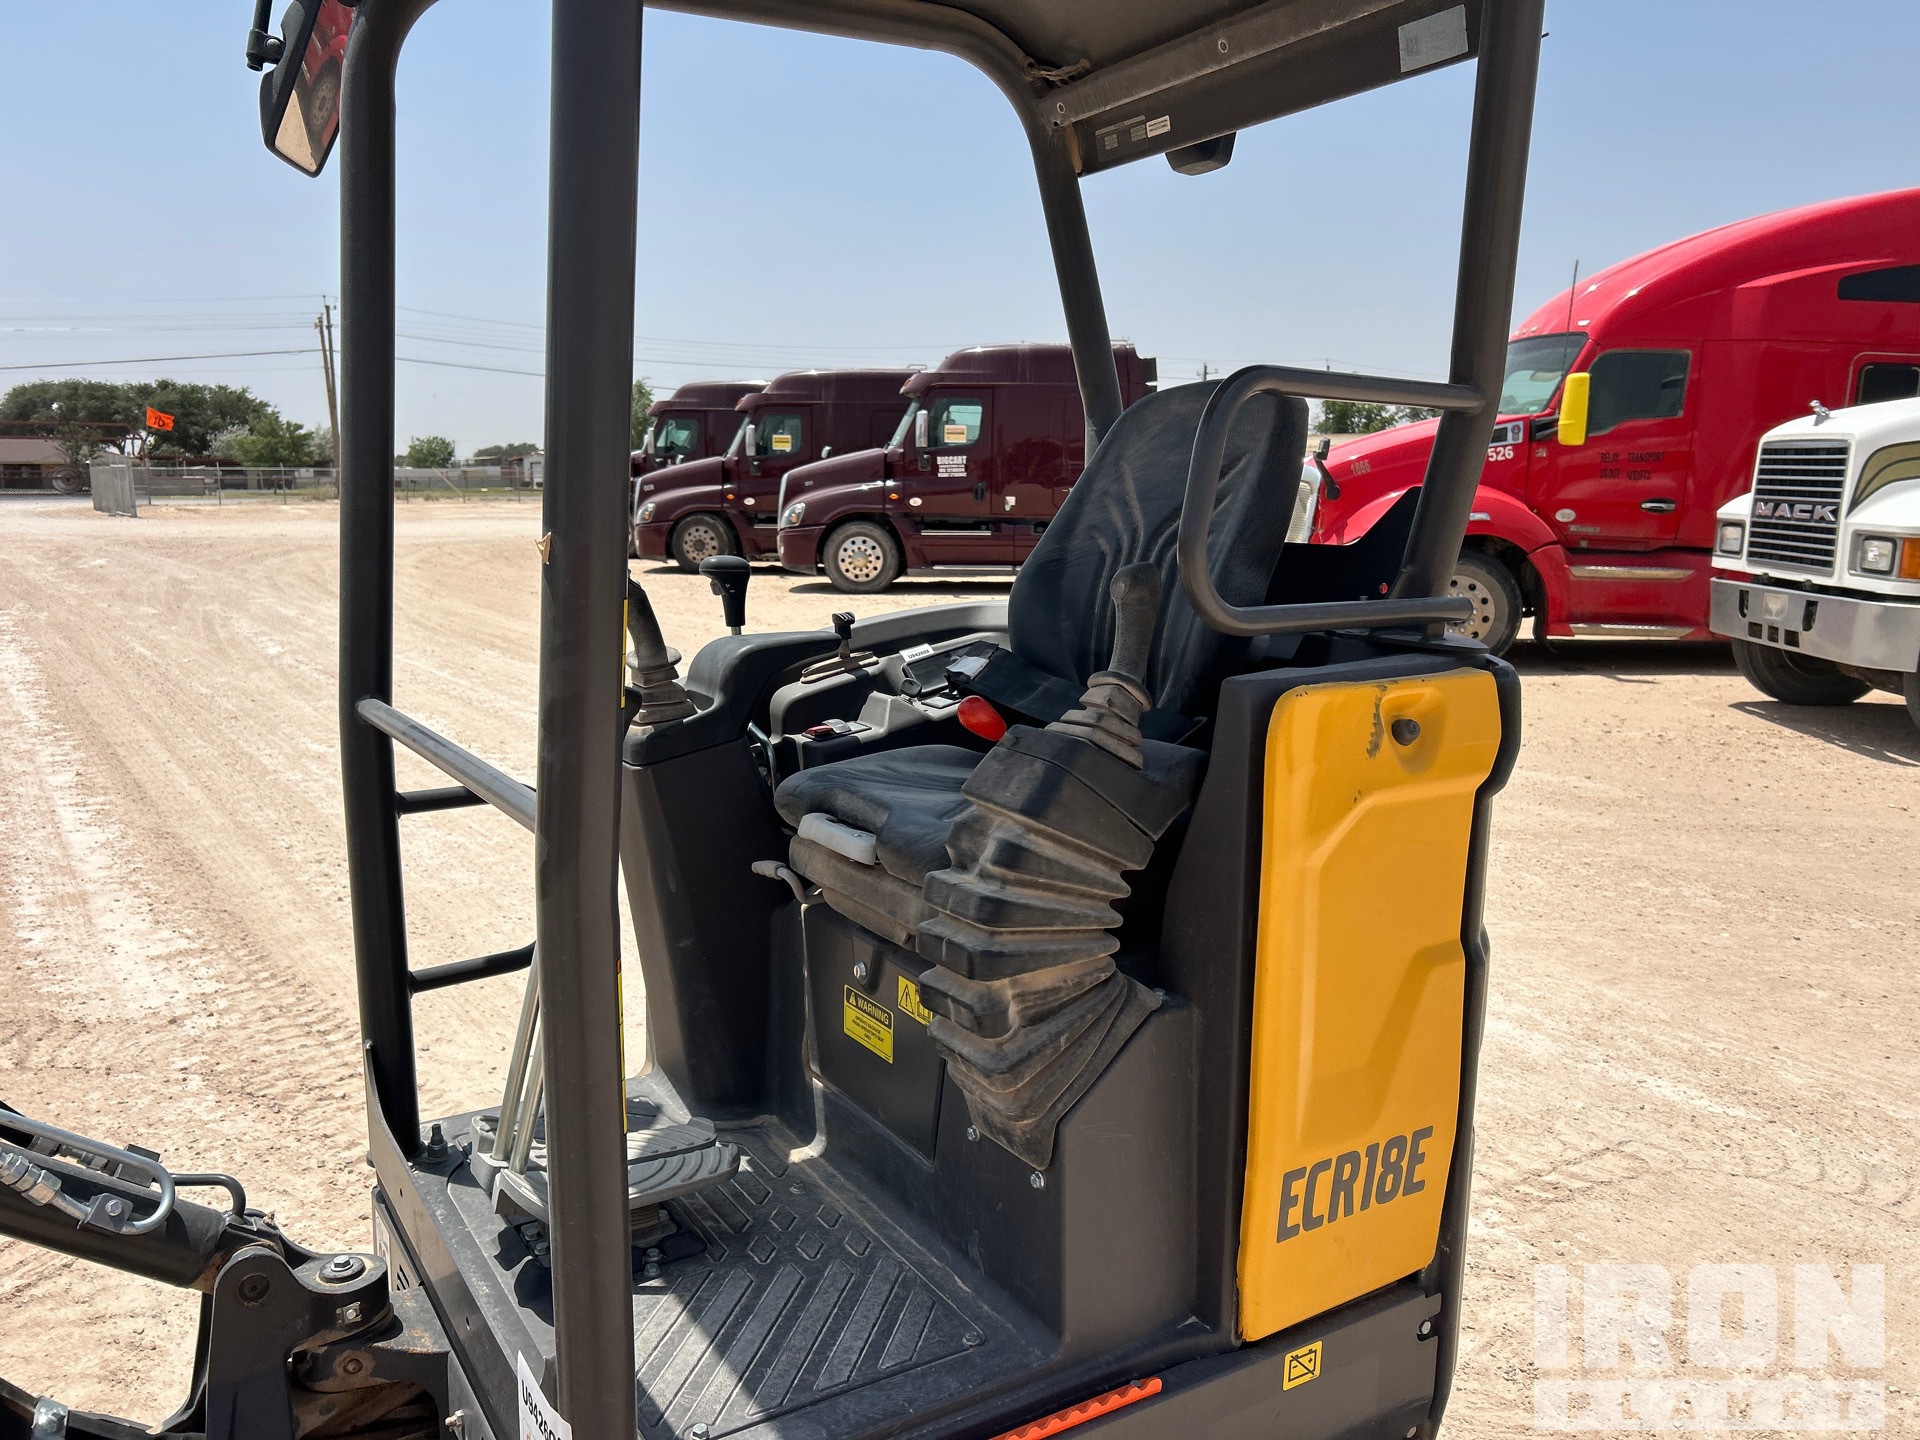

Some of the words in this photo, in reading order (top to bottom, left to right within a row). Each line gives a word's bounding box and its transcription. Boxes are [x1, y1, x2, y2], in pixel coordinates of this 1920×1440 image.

[1488, 445, 1514, 462] 526
[1755, 501, 1837, 522] MACK
[858, 997, 889, 1025] WARNING
[1276, 1125, 1434, 1244] ECR18E
[521, 1379, 562, 1440] U94260
